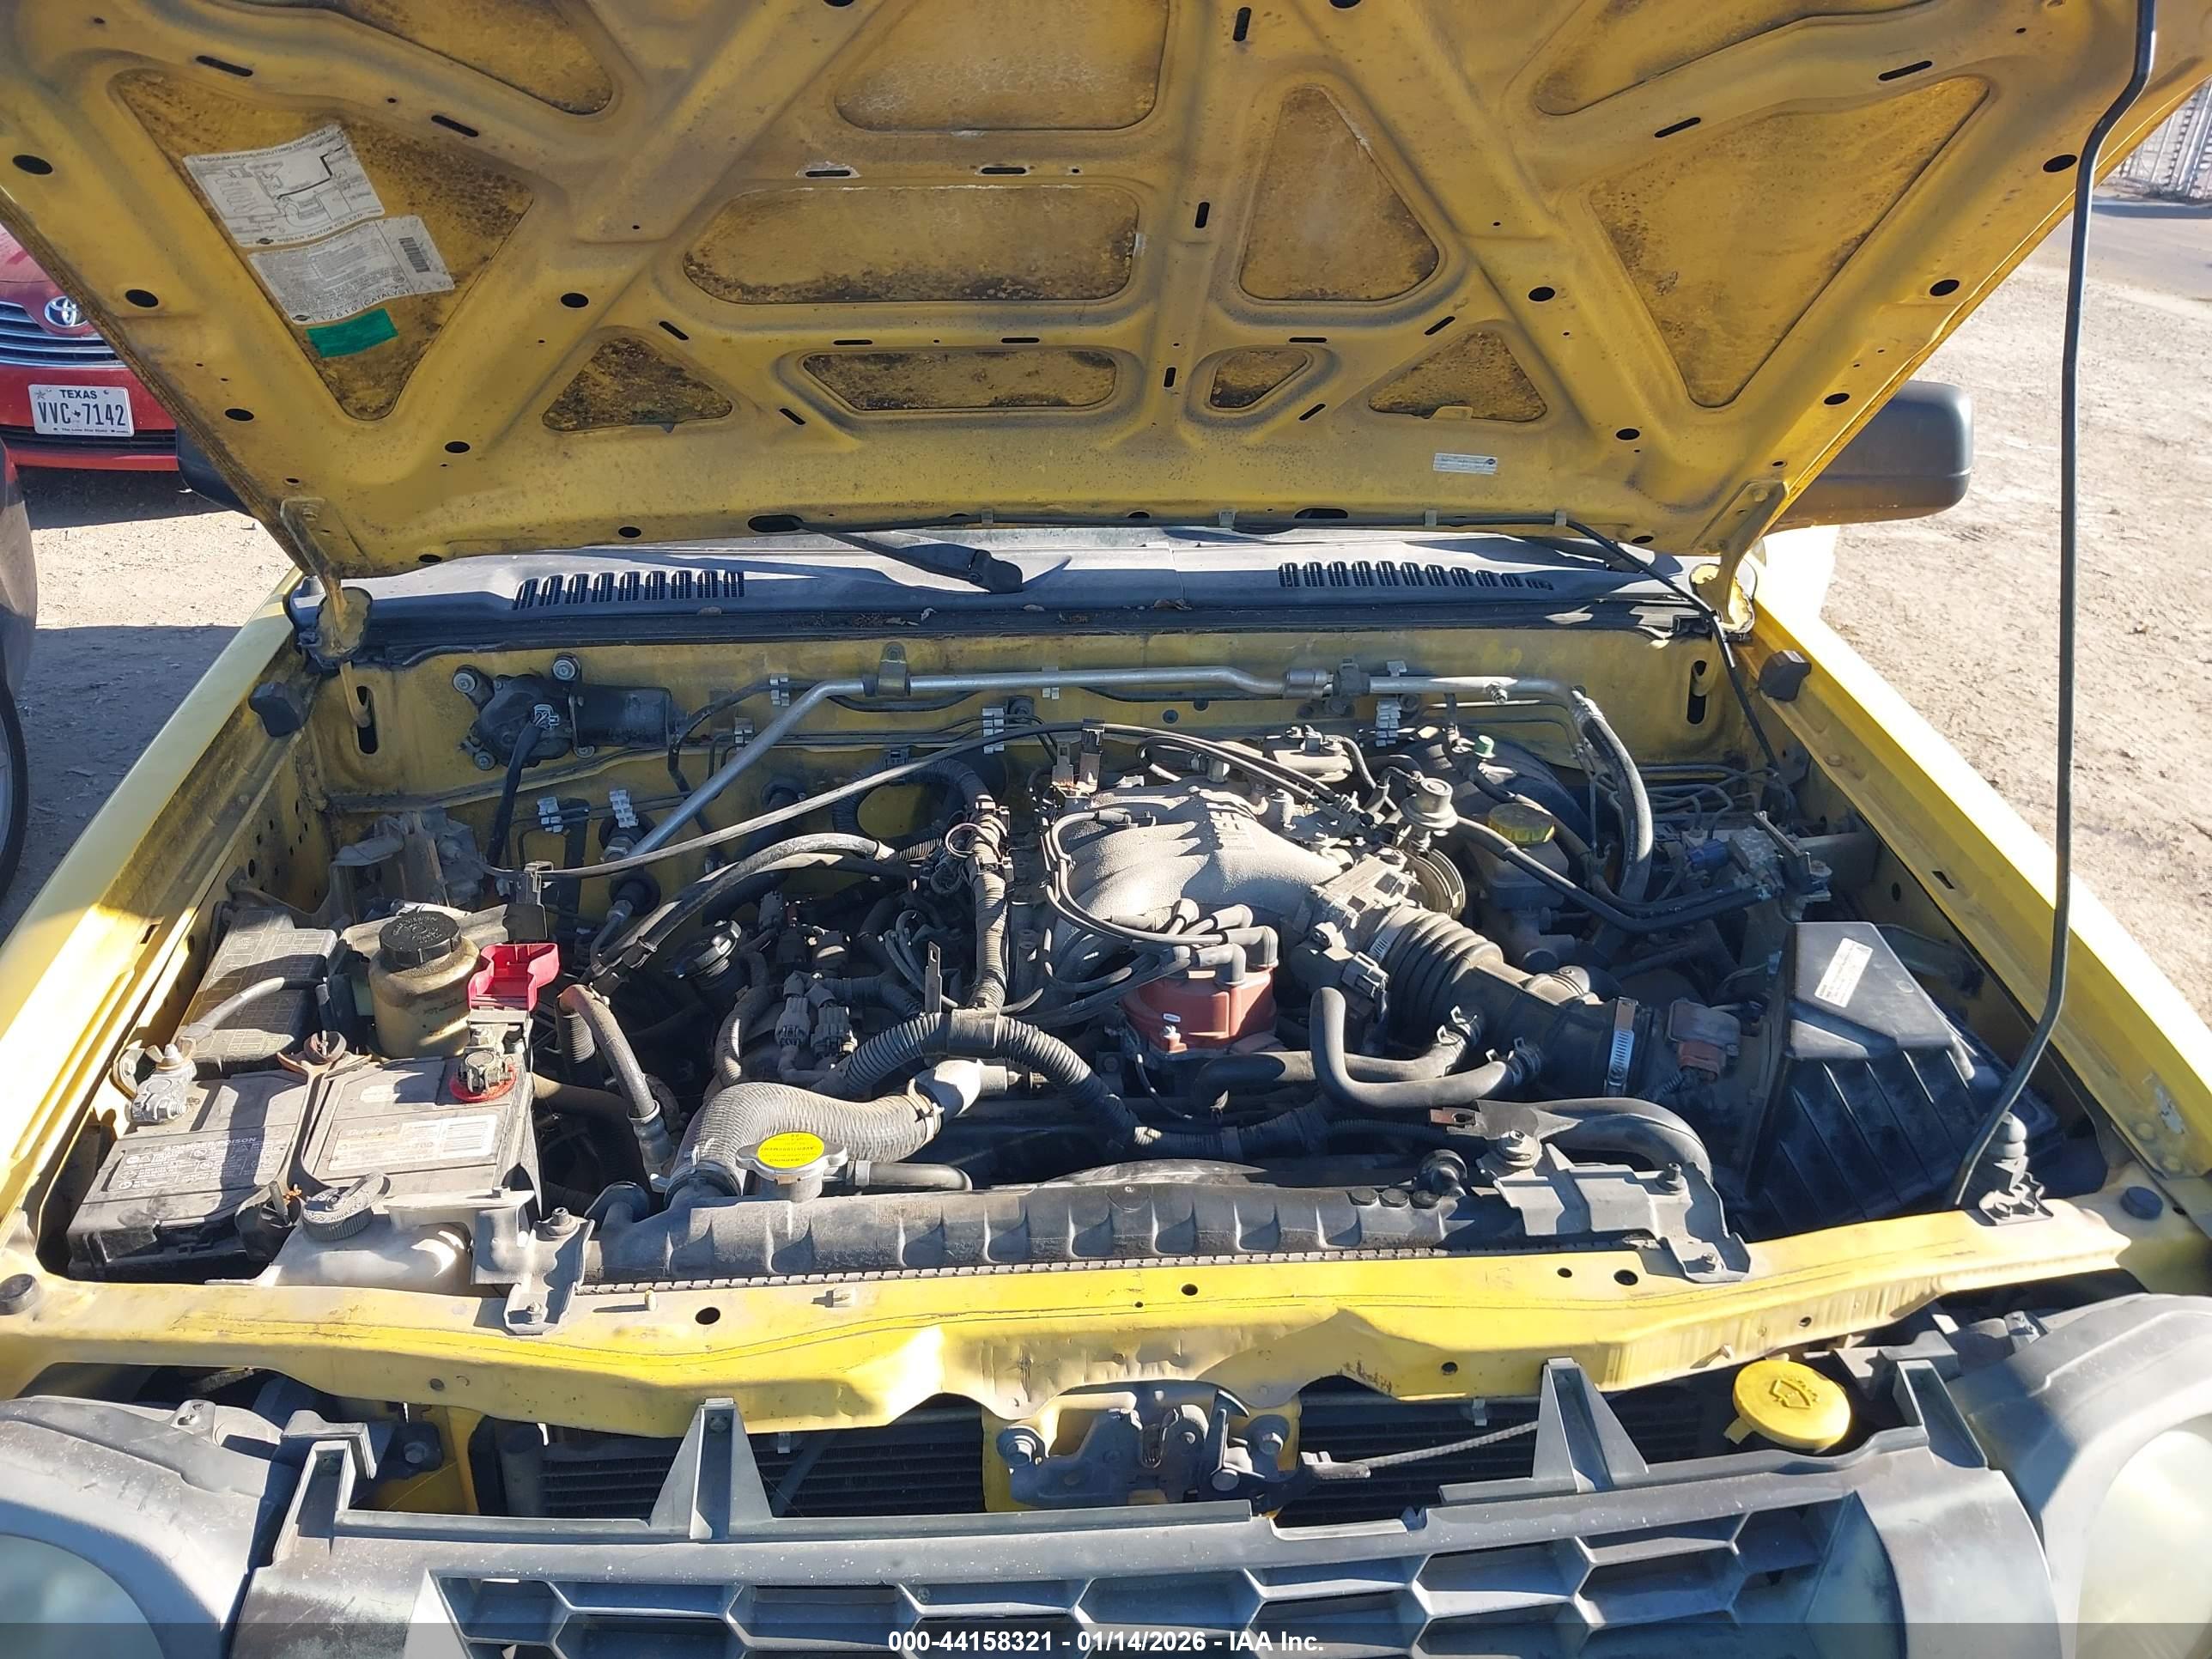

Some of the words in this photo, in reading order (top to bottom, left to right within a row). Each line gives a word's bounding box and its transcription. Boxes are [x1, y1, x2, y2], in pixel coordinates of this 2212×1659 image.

[256, 145, 293, 158] ROUTING
[294, 130, 327, 149] DIAGRAM
[307, 225, 333, 238] MOTOR
[363, 288, 410, 307] CATALYST
[59, 389, 98, 399] TEXAS
[82, 403, 126, 426] 7142
